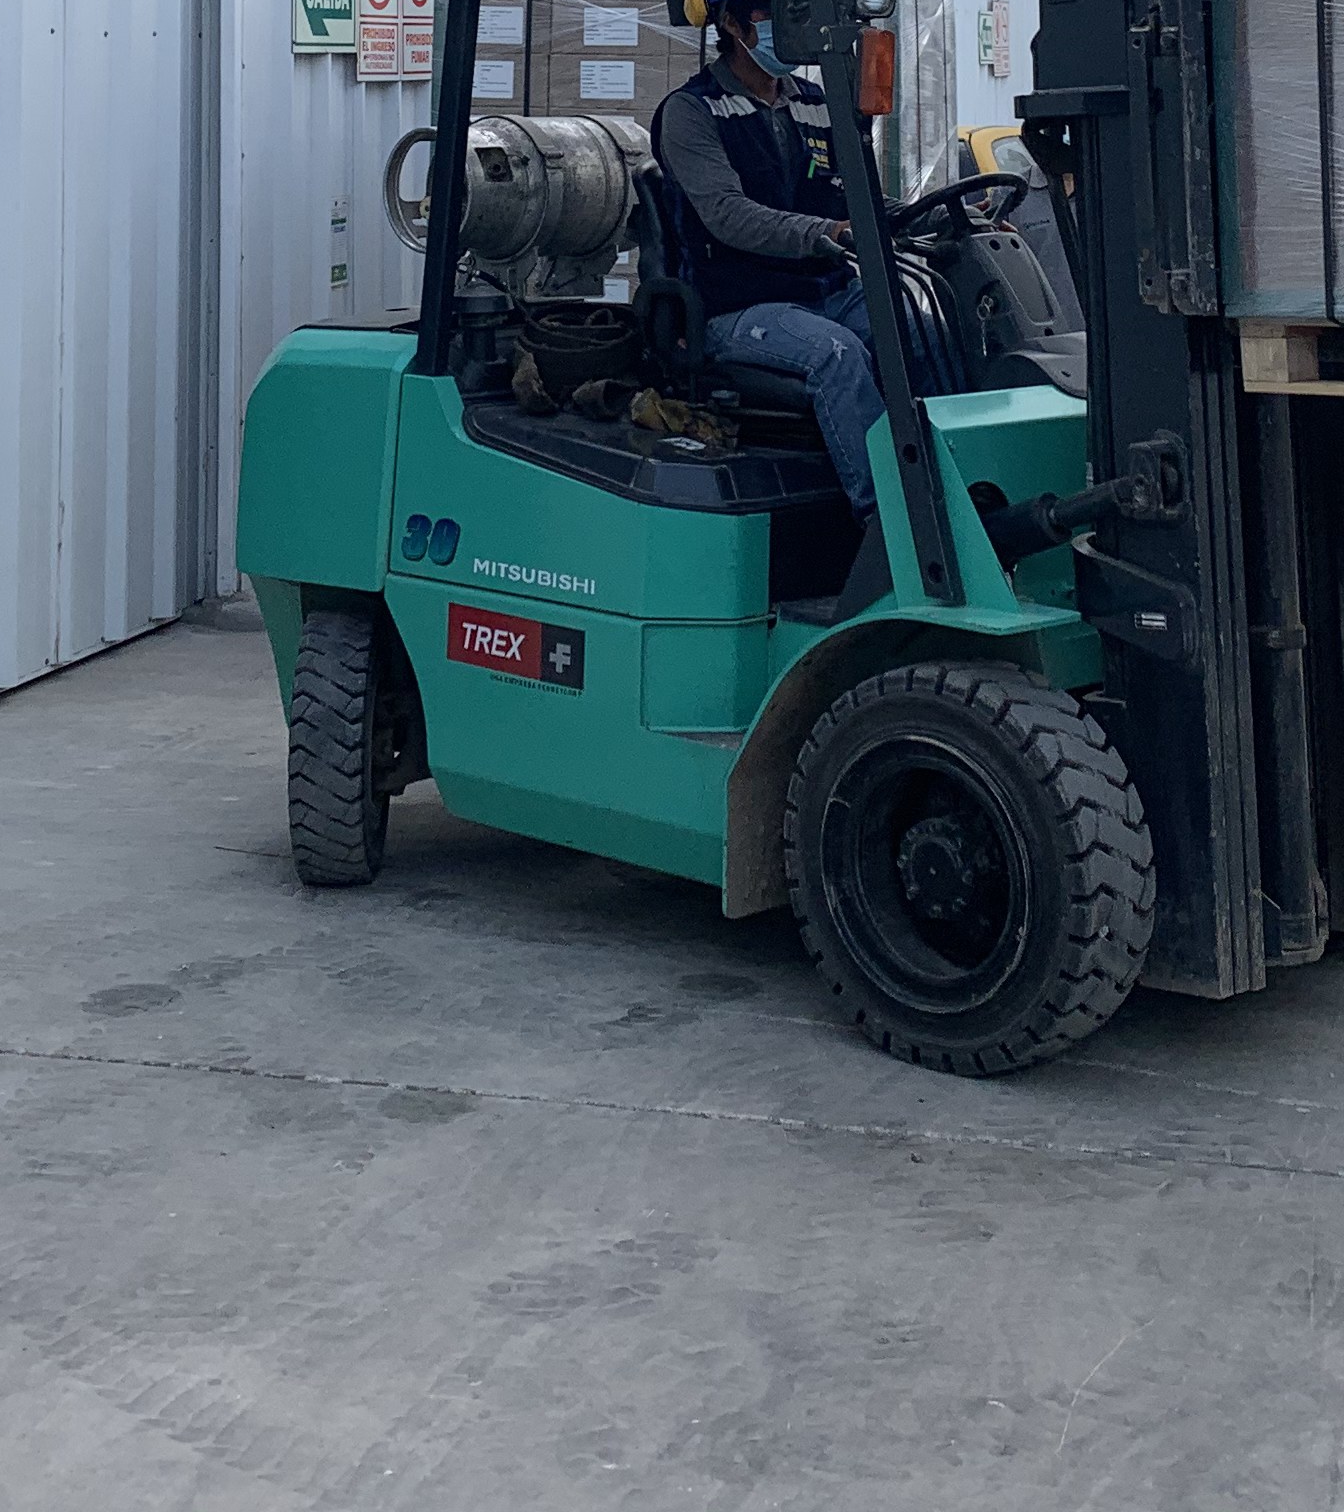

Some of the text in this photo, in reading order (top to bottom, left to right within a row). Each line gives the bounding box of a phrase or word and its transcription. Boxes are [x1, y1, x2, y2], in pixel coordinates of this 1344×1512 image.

[400, 514, 461, 566] 30
[472, 557, 596, 595] MITSUBISHI
[461, 622, 525, 662] TREX
